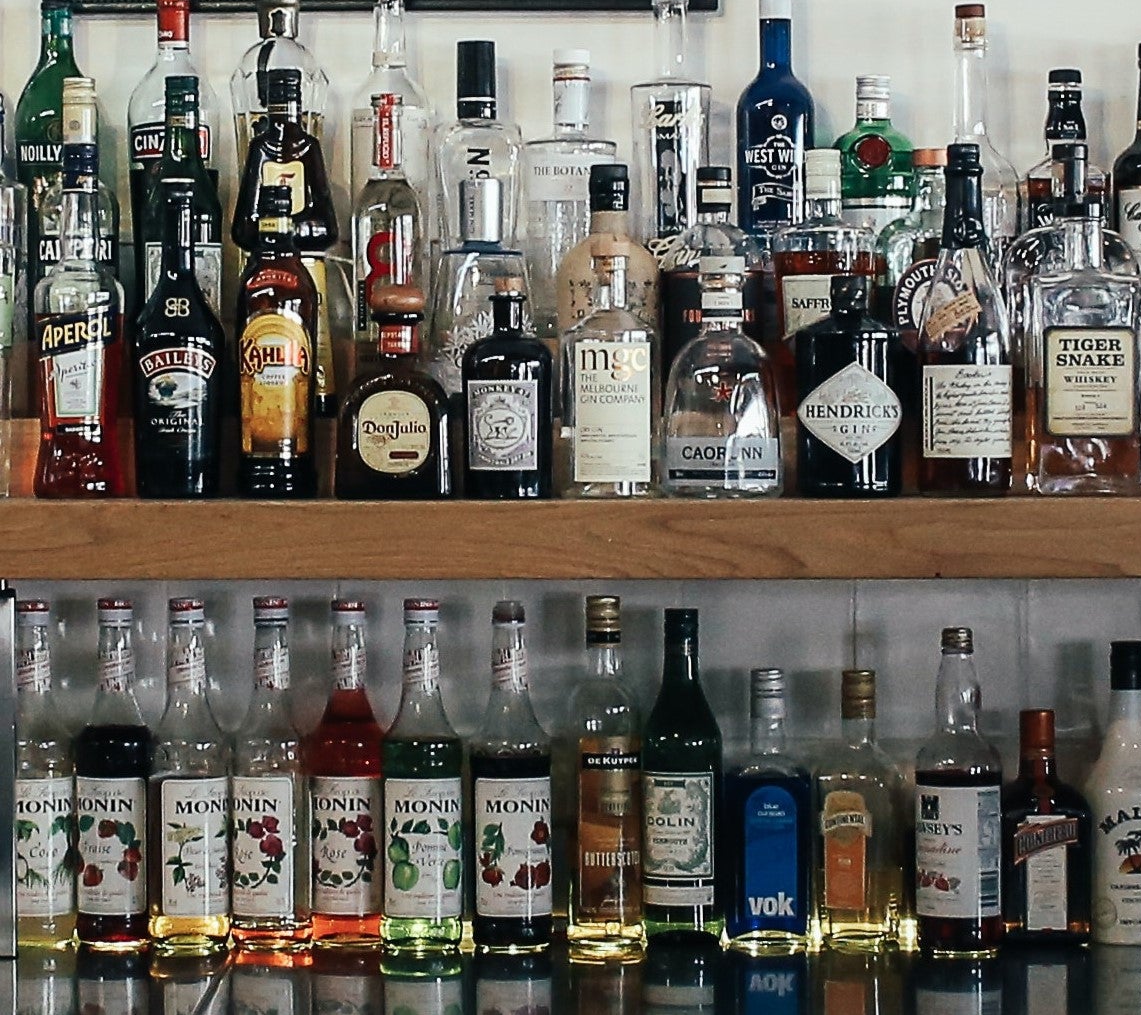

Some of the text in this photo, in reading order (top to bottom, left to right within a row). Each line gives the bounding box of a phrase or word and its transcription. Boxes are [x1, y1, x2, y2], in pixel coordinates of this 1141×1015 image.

[20, 144, 63, 162] NOILLY
[897, 264, 937, 326] PLYMOUTH
[41, 317, 112, 351] APEROL
[1058, 338, 1122, 352] TIGER
[143, 349, 213, 375] BAILEYS
[580, 347, 647, 382] mgc
[1056, 353, 1126, 367] SNAKE
[580, 373, 598, 383] THE
[1063, 375, 1119, 385] WHISKEY
[580, 395, 646, 405] GIN COMPANY
[805, 402, 899, 419] HENDRICK'S
[394, 799, 460, 814] MONIN
[748, 891, 795, 917] vok
